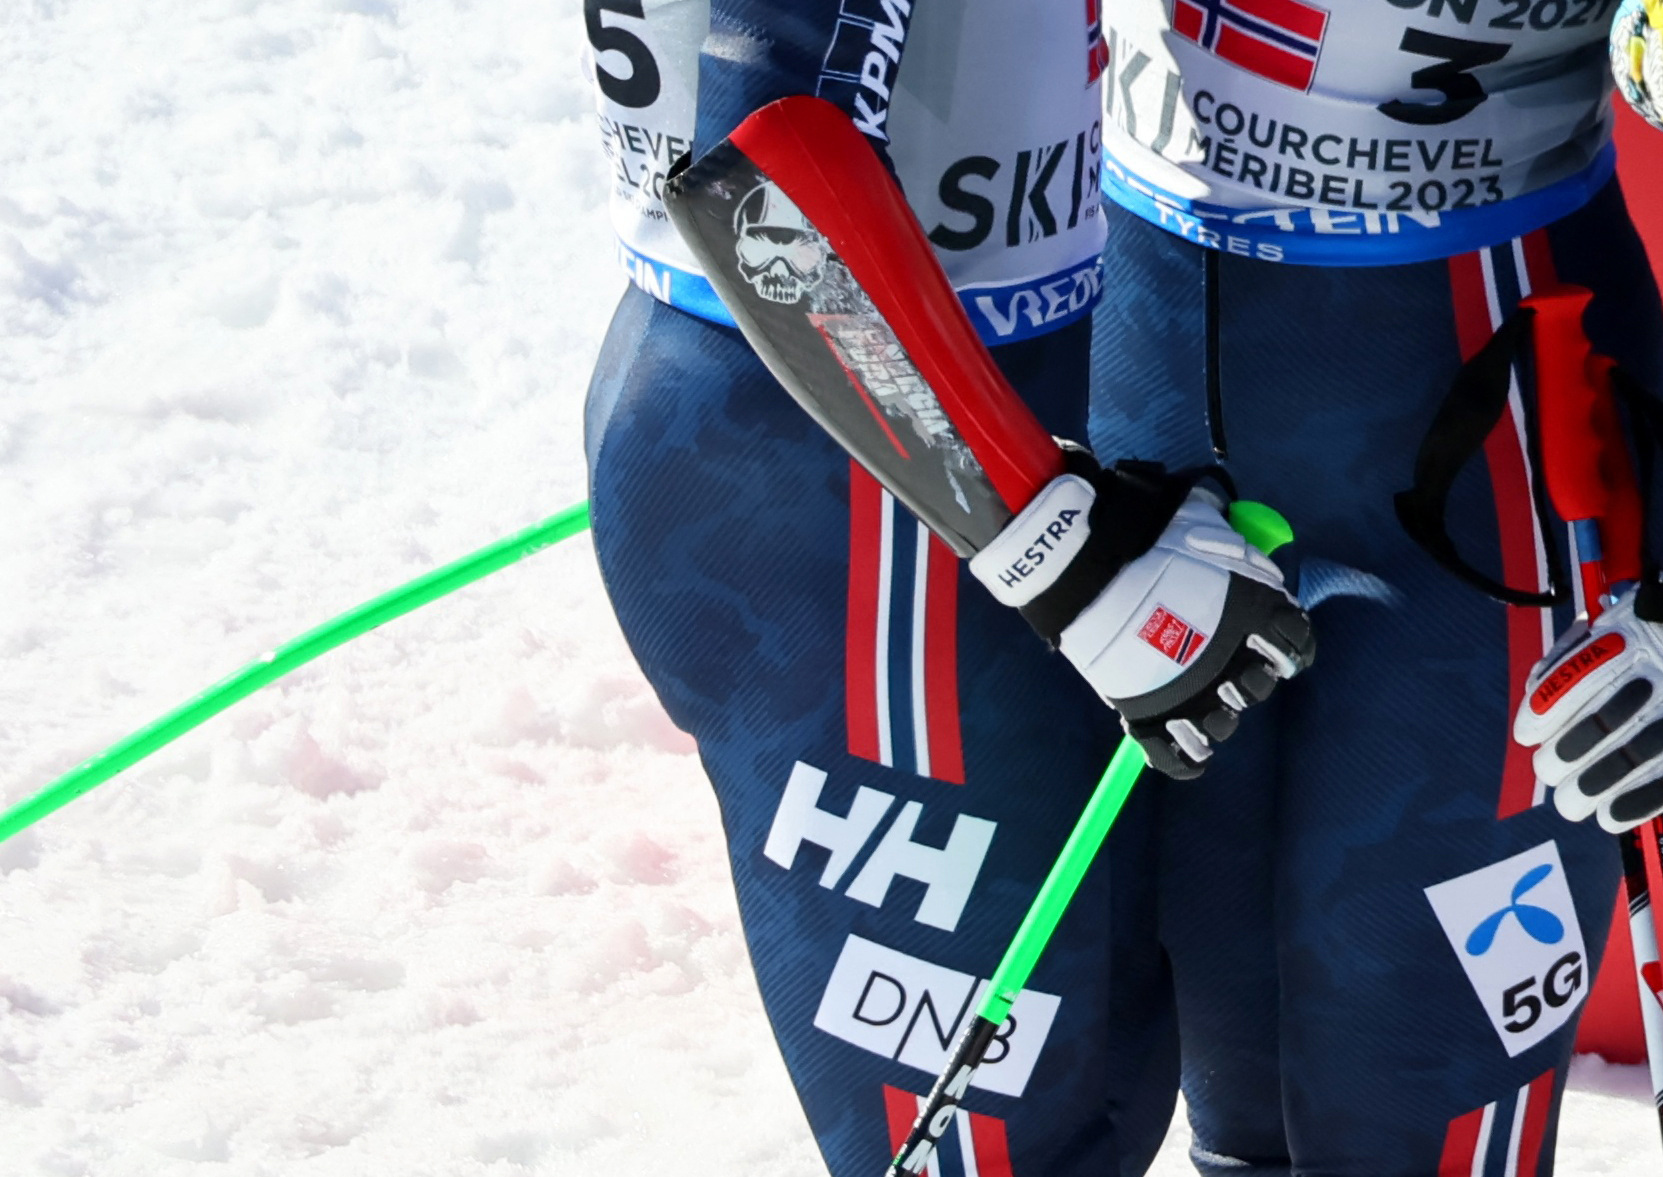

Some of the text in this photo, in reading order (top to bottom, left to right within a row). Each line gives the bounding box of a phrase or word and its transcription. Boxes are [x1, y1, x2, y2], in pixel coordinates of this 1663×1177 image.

[1376, 26, 1513, 125] 3
[1187, 127, 1505, 214] MÉRIBEL 2023
[1192, 90, 1503, 169] COURCHEVEL
[928, 131, 1086, 252] SKI
[1153, 200, 1285, 262] TYRES
[998, 507, 1082, 589] HESTRA
[1538, 642, 1607, 706] HESTRA
[763, 760, 998, 933] HH
[1501, 951, 1585, 1034] 5G
